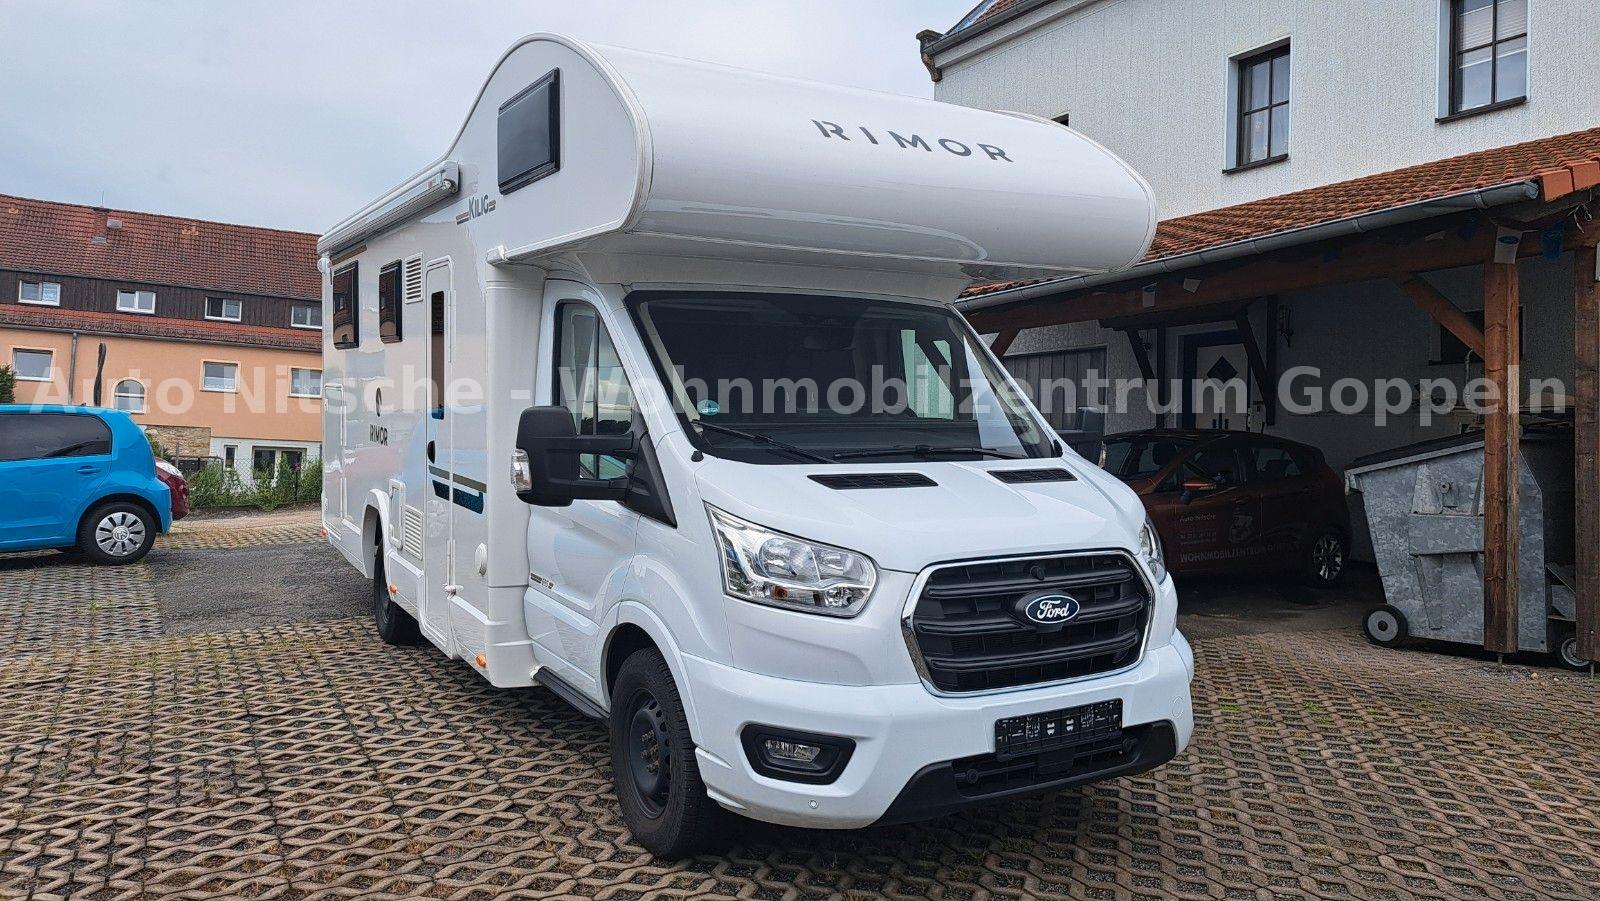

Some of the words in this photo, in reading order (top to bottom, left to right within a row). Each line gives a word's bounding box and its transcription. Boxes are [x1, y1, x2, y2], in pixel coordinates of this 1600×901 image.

[811, 119, 1014, 163] RIMOR
[468, 194, 489, 220] KILIG
[369, 424, 388, 446] RIMOR
[1037, 600, 1070, 619] Ford
